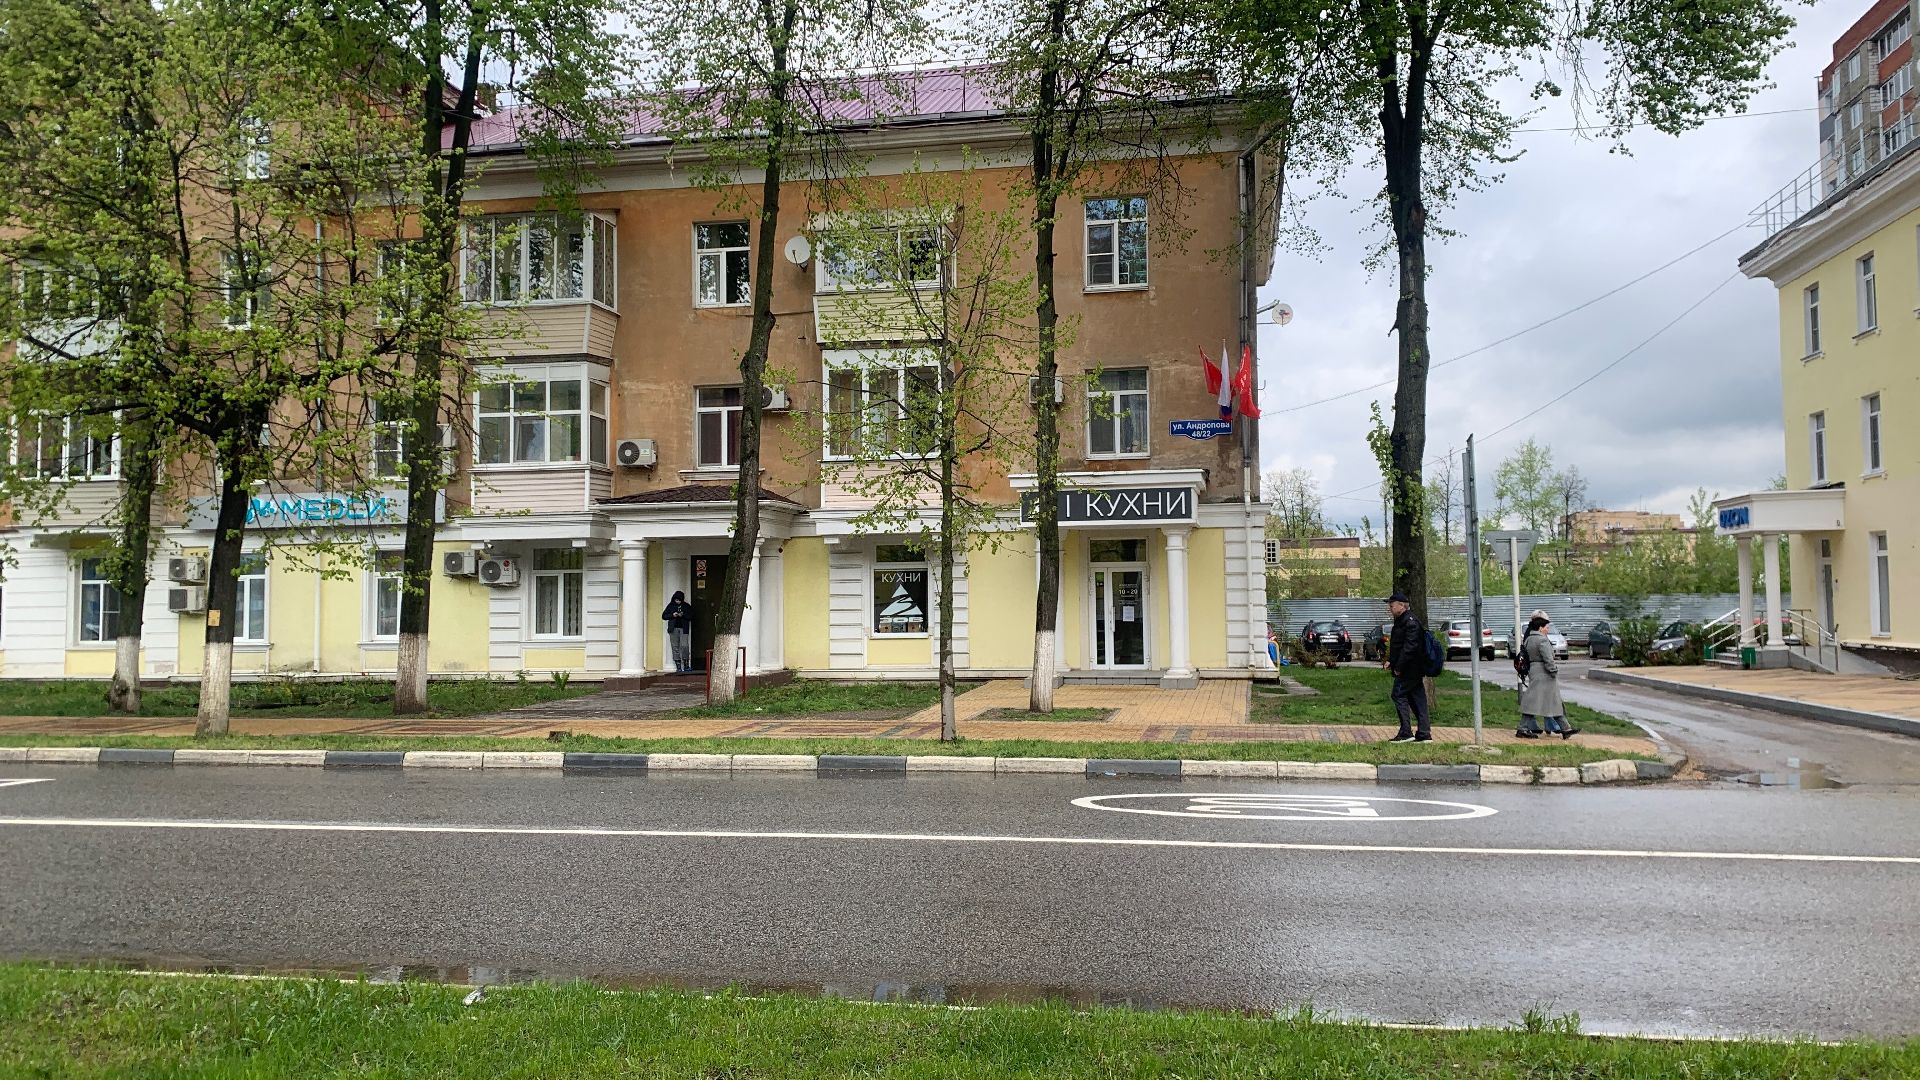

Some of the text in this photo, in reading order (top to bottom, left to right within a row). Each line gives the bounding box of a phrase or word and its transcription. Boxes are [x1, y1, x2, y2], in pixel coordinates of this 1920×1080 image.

[1172, 421, 1230, 431] ул. Андропова
[1191, 430, 1211, 438] 48/22
[1086, 491, 1187, 518] КУХНИ
[880, 572, 921, 583] КУХНИ
